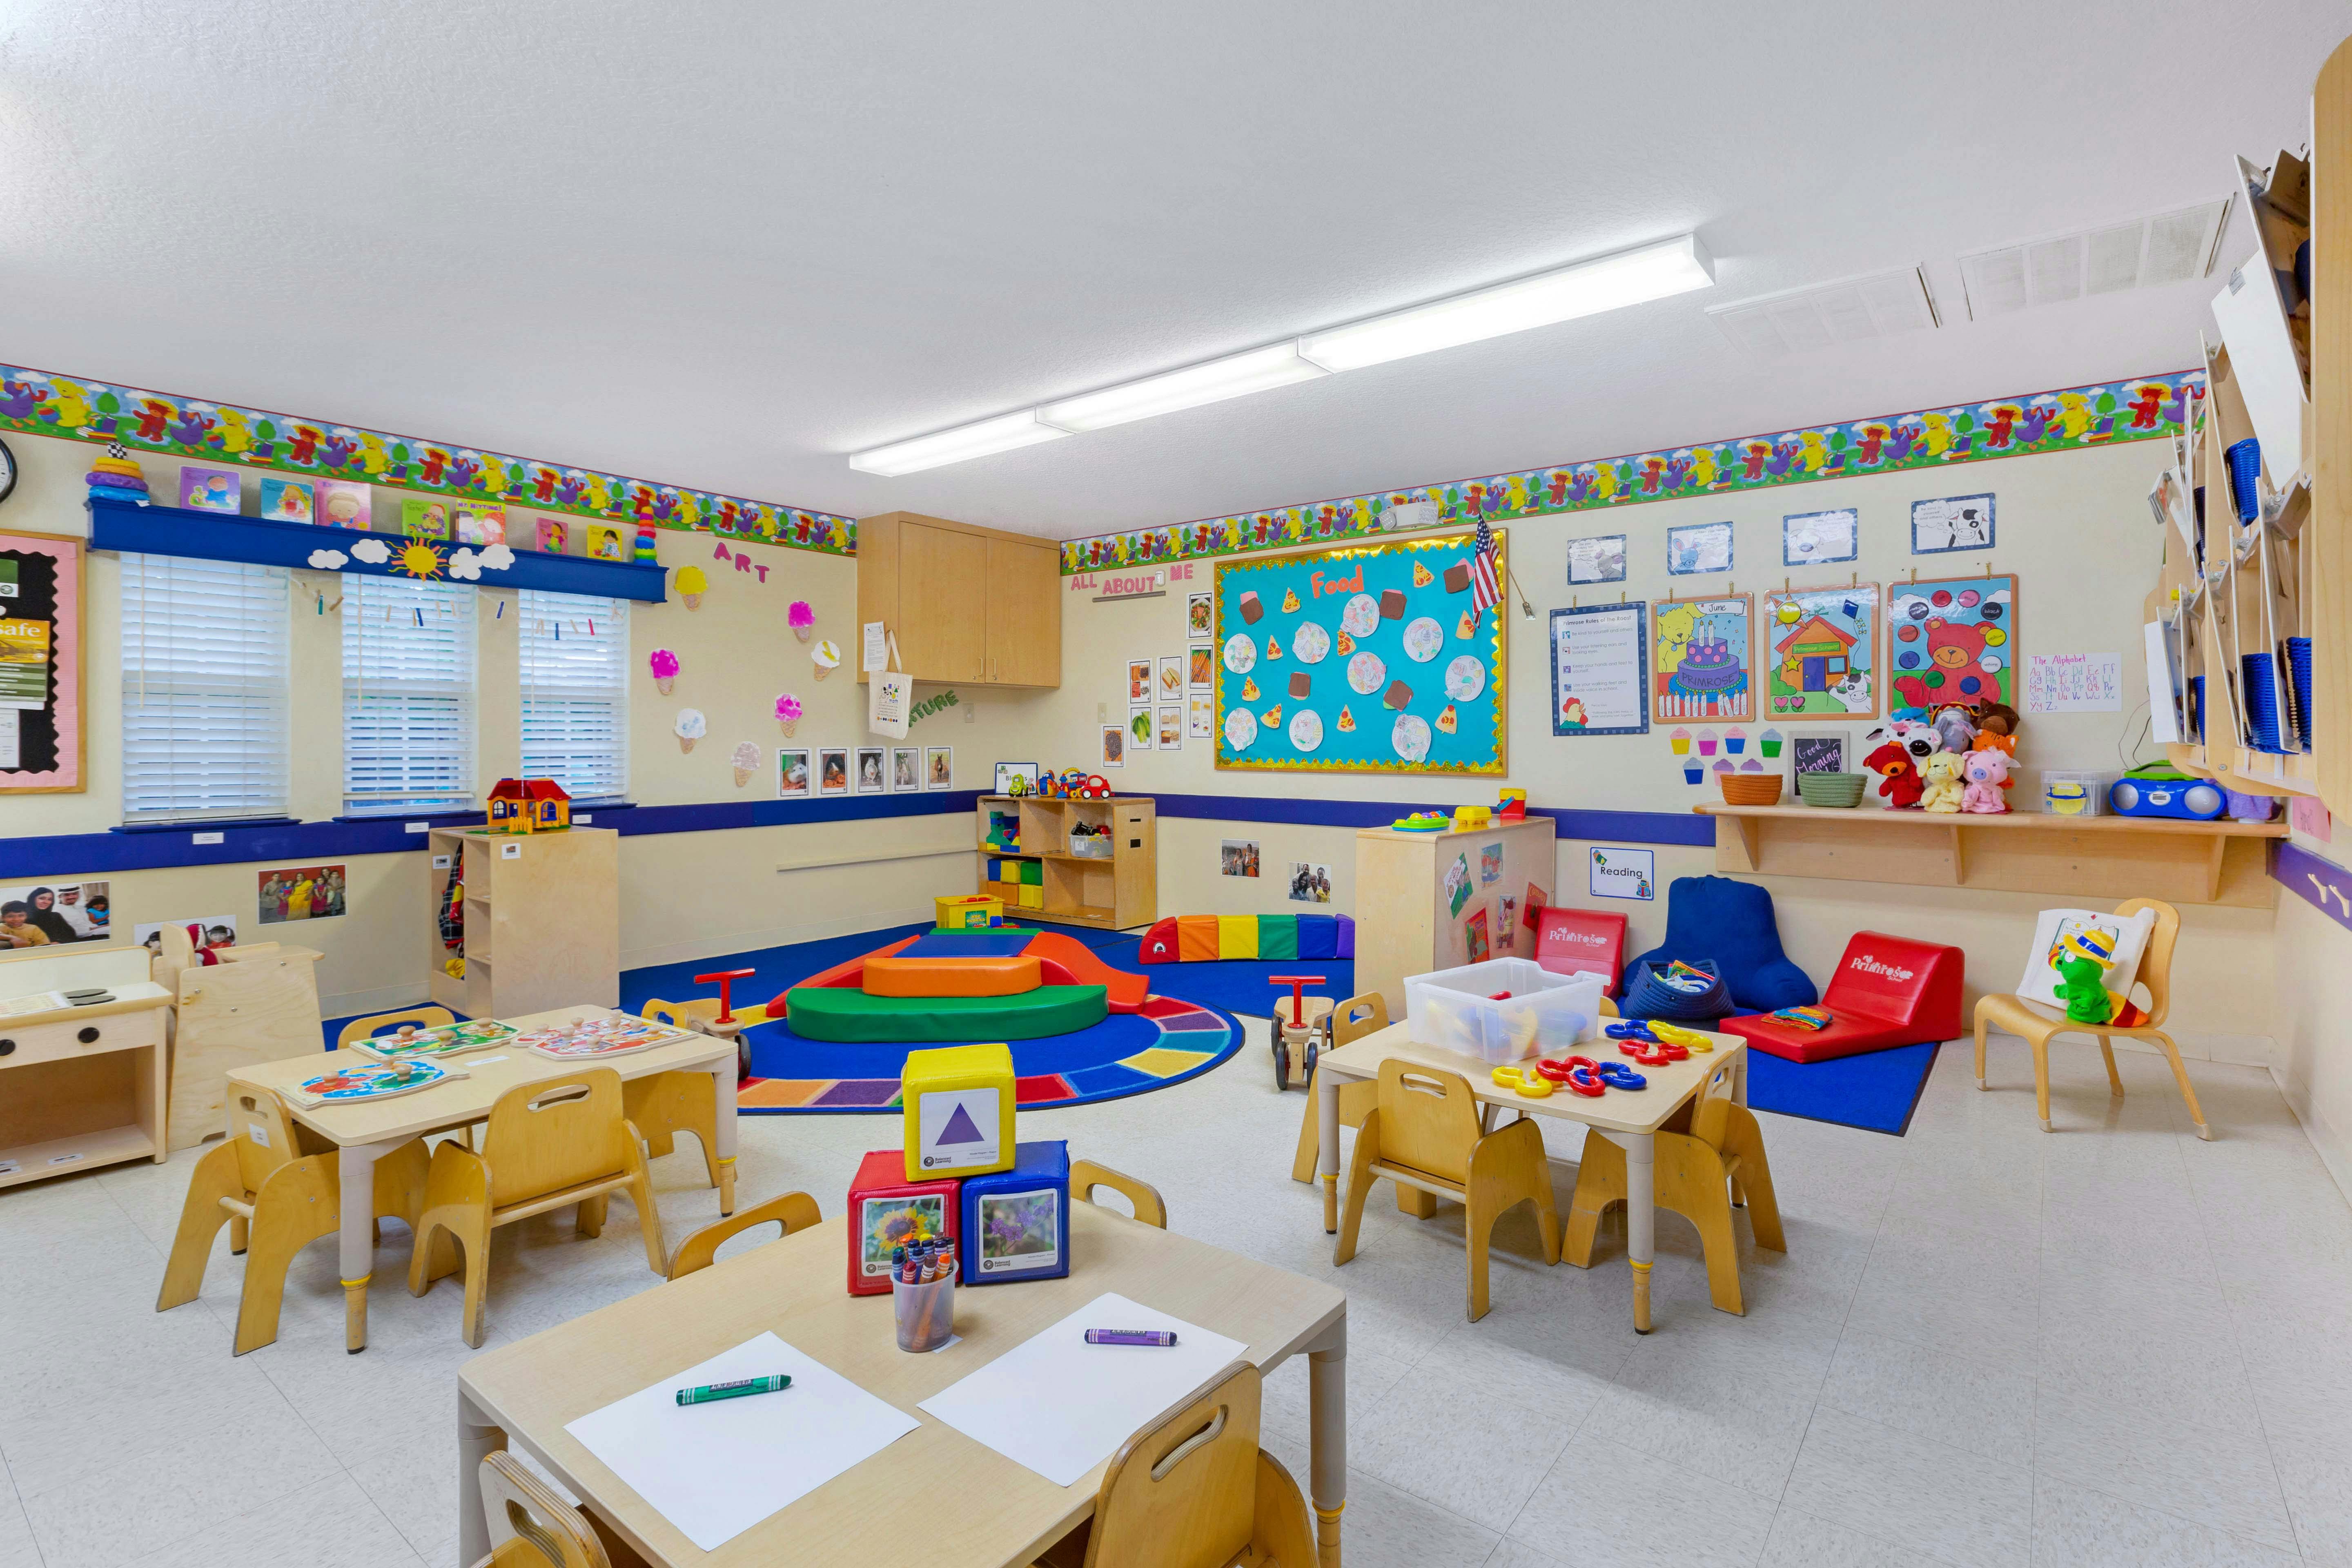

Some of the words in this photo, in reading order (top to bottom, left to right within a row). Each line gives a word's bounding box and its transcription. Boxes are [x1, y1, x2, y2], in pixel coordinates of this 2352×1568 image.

[713, 542, 770, 584] ART
[1071, 573, 1097, 591] ALL
[1102, 576, 1155, 595] ABOUT
[1170, 563, 1193, 581] ME
[1311, 564, 1364, 599] Food
[1708, 604, 1726, 612] June
[2031, 656, 2047, 666] The
[2052, 654, 2086, 666] Alphabet
[1682, 671, 1738, 688] PRIMROSE
[909, 690, 959, 728] ATURE
[1797, 739, 1830, 759] Good
[1796, 749, 1842, 773] Morning
[1601, 866, 1643, 879] Reading
